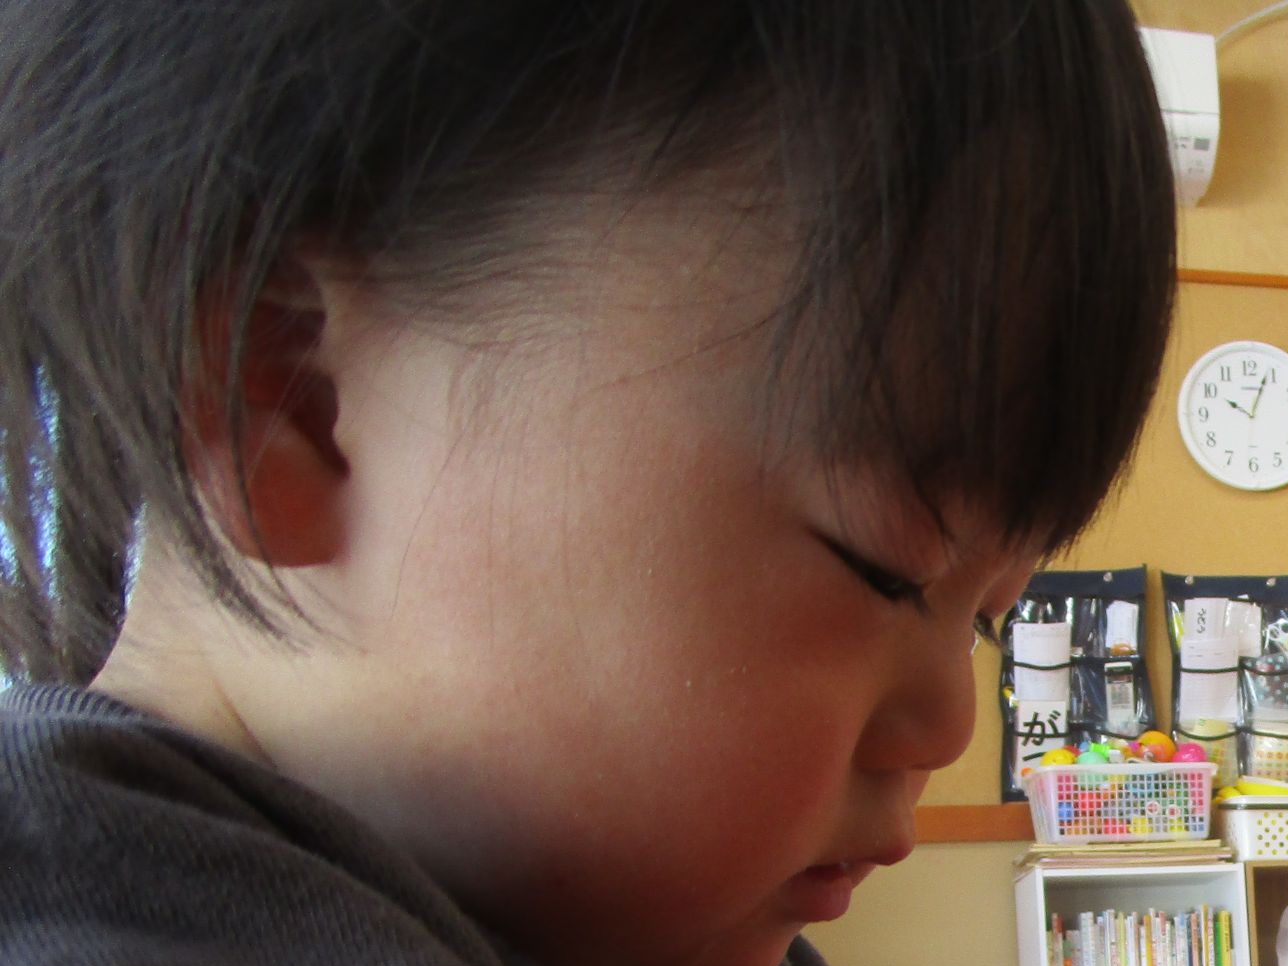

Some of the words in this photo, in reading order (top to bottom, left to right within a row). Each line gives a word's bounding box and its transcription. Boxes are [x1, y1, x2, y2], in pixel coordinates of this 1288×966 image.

[1220, 365, 1232, 382] 11
[1242, 360, 1258, 377] 12
[1271, 368, 1277, 384] 1
[1203, 382, 1218, 399] 10
[1198, 406, 1209, 423] 9
[1206, 431, 1217, 448] 8
[1225, 450, 1234, 466] 7
[1249, 457, 1259, 473] 6
[1272, 452, 1282, 468] 5
